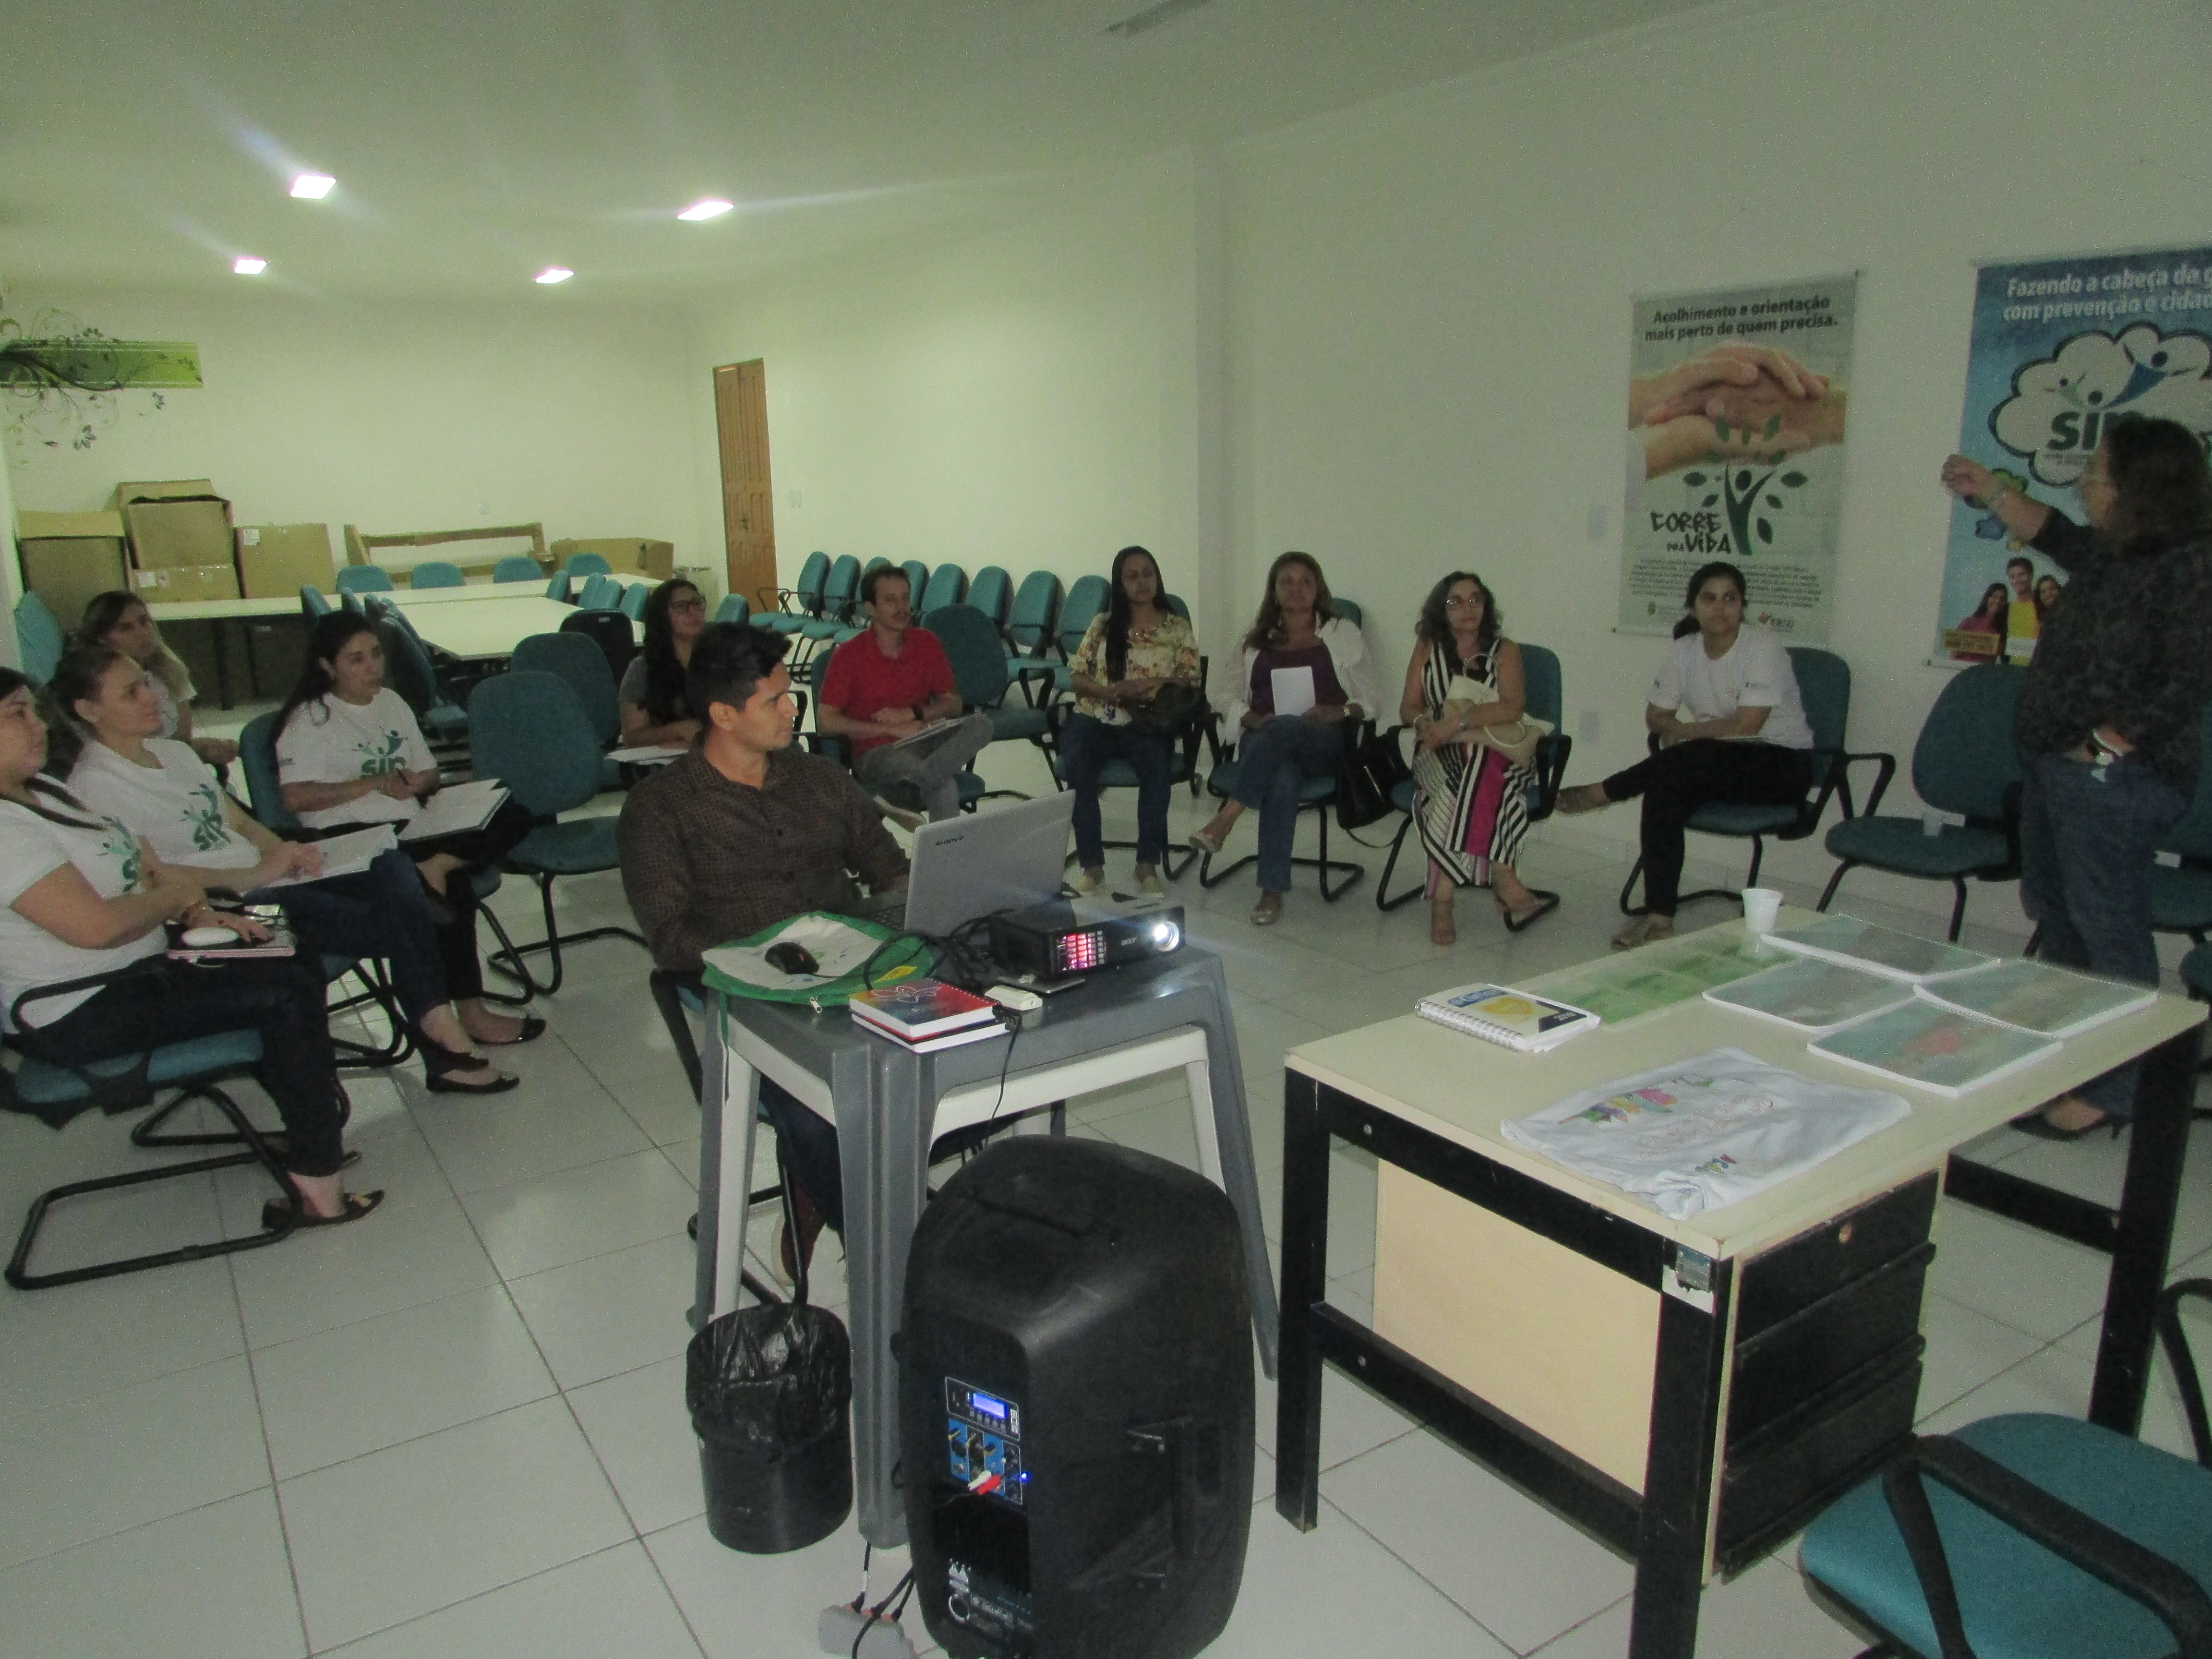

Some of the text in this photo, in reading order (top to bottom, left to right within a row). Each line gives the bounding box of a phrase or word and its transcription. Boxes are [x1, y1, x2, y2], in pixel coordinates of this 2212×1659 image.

[2007, 273, 2082, 298] Fazendo
[2086, 276, 2099, 291] a
[2102, 268, 2168, 292] cabeça
[2173, 263, 2200, 286] da
[1653, 295, 1830, 324] Acolhimento e orientação
[2003, 305, 2039, 321] com
[2043, 294, 2140, 324] prevenção
[2145, 297, 2156, 312] e
[1645, 313, 1838, 341] mais perto de quem precisa.
[1650, 511, 1722, 533] CORRE
